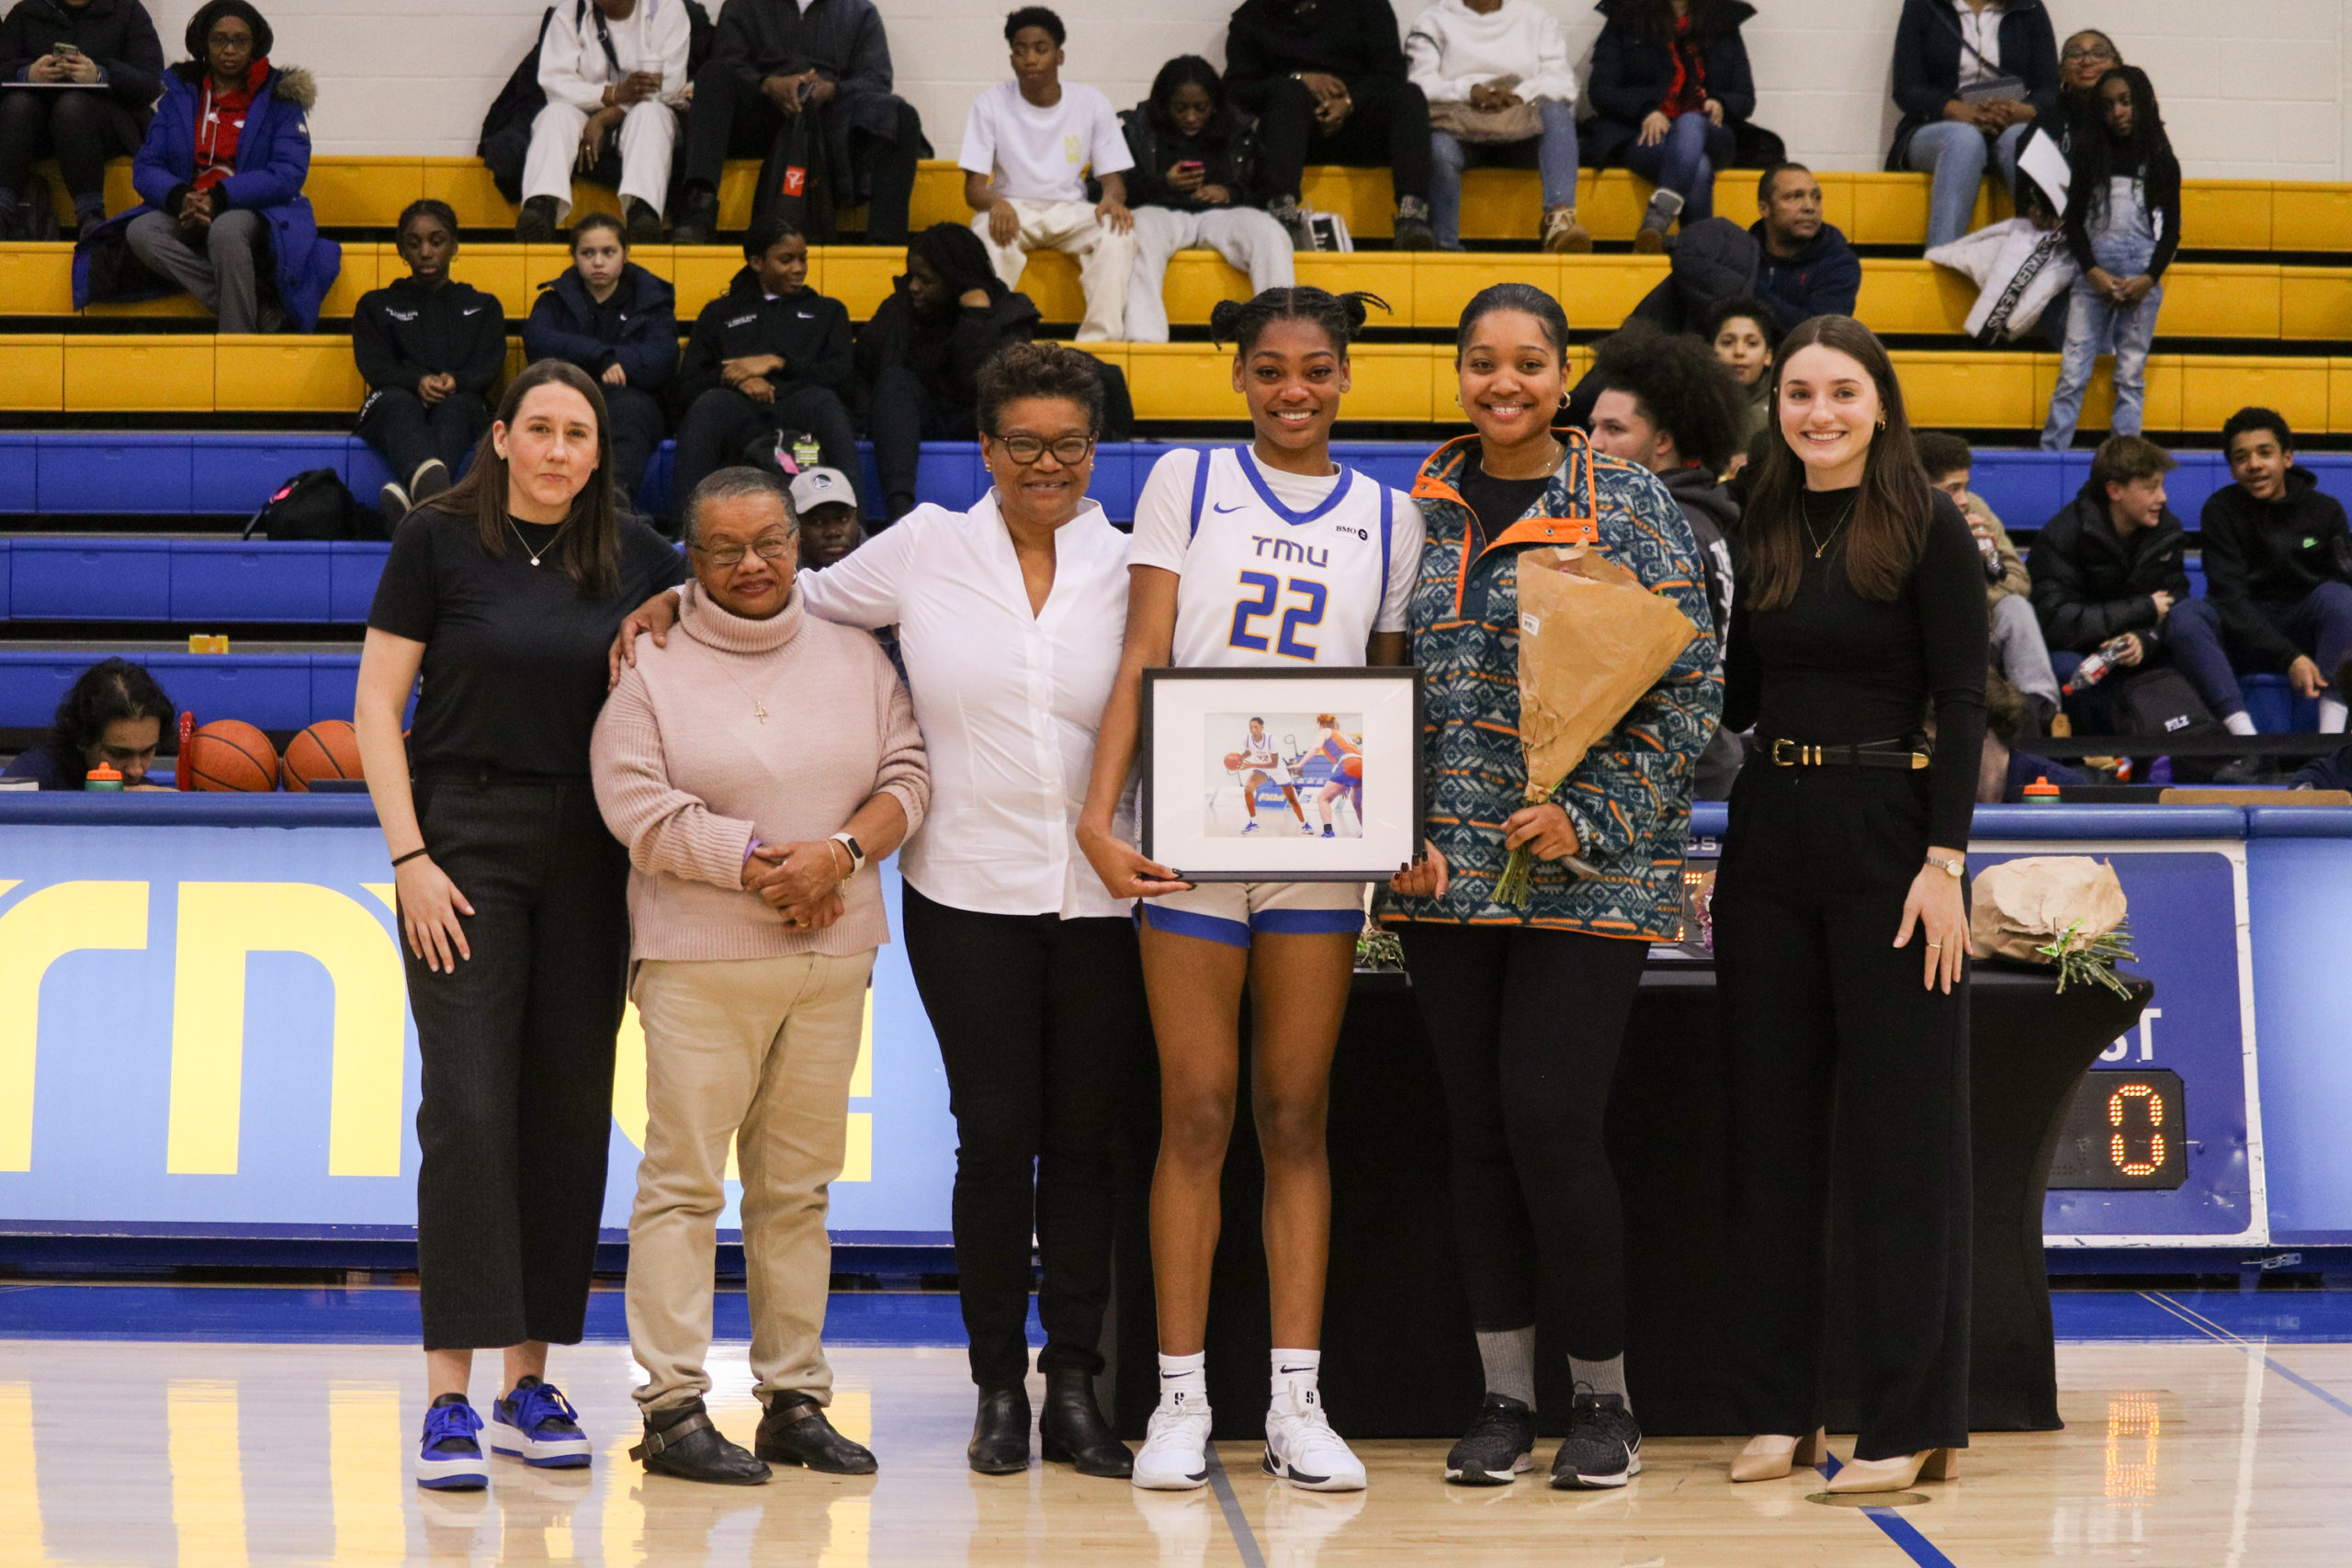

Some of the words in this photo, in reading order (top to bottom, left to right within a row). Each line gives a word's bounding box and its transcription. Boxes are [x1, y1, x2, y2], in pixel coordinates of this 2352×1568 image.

[1251, 535, 1329, 569] TMU
[1336, 525, 1357, 535] BMO
[1227, 569, 1329, 663] 22
[2109, 1084, 2165, 1177] 0
